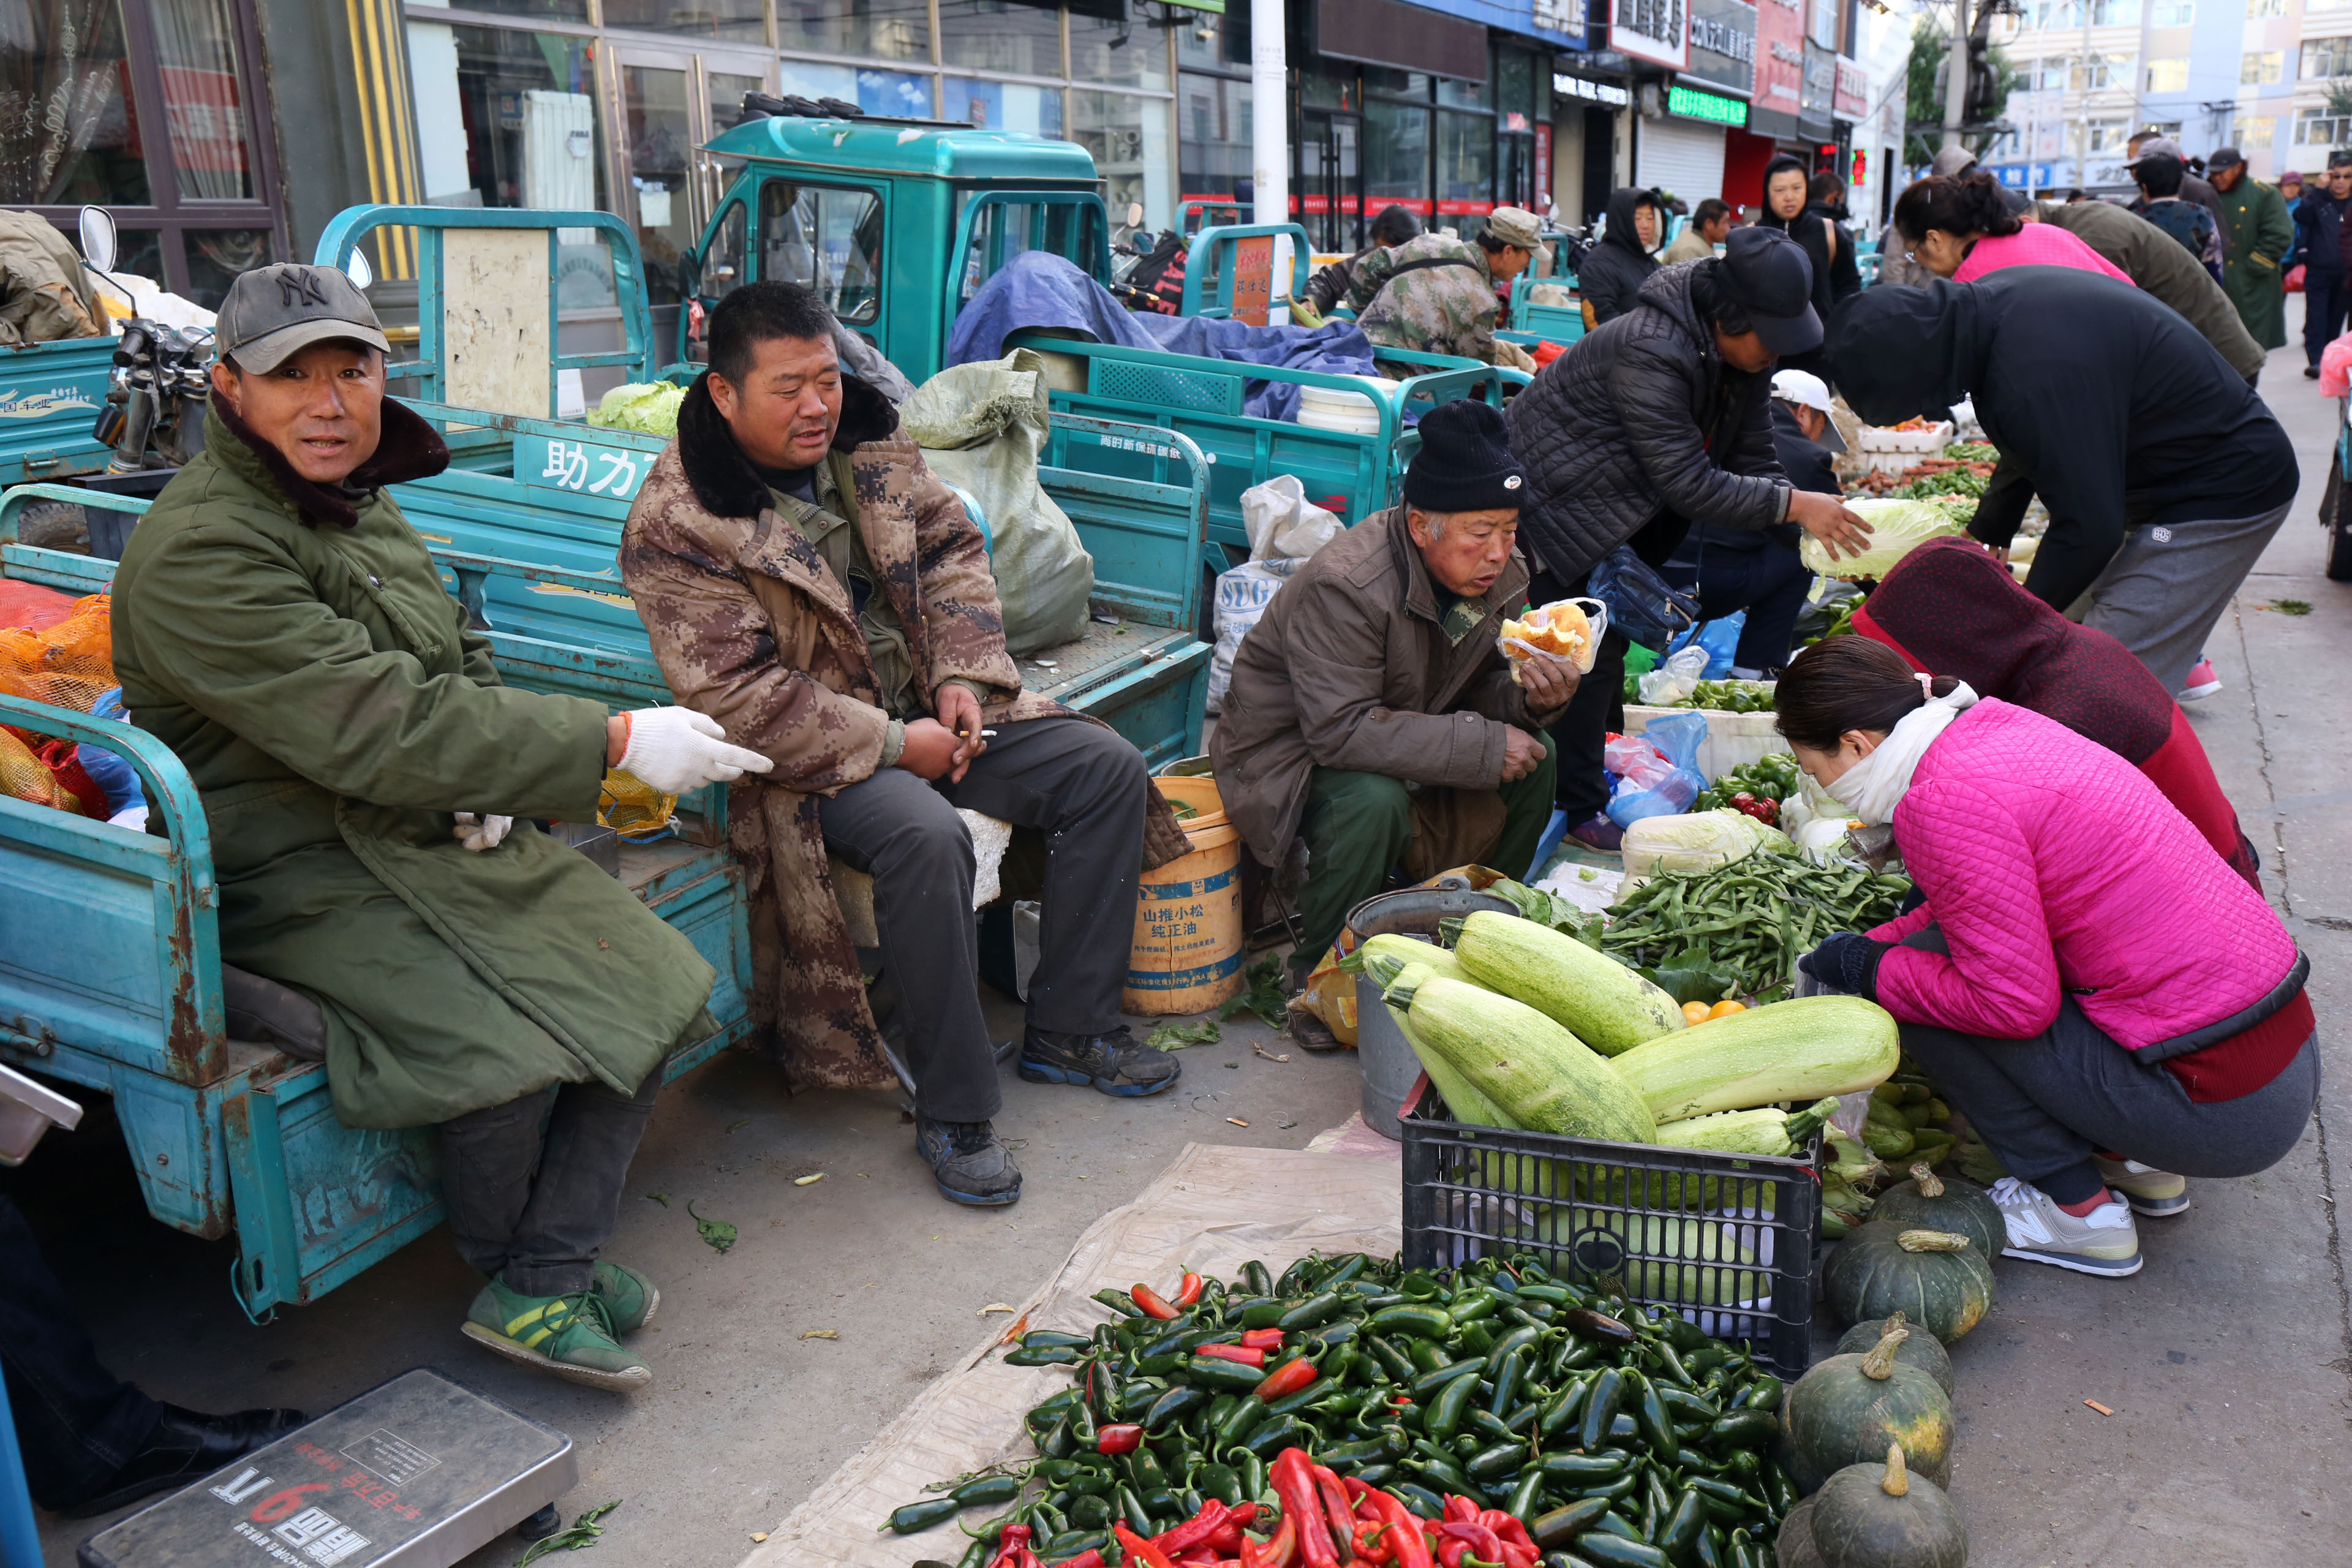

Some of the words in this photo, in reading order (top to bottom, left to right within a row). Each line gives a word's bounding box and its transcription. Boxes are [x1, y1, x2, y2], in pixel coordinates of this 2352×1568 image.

[276, 267, 329, 307] NY
[542, 440, 658, 497] 助力
[1222, 579, 1283, 607] SUG
[1143, 903, 1204, 922] 山推小松
[1151, 921, 1197, 938] 纯正油
